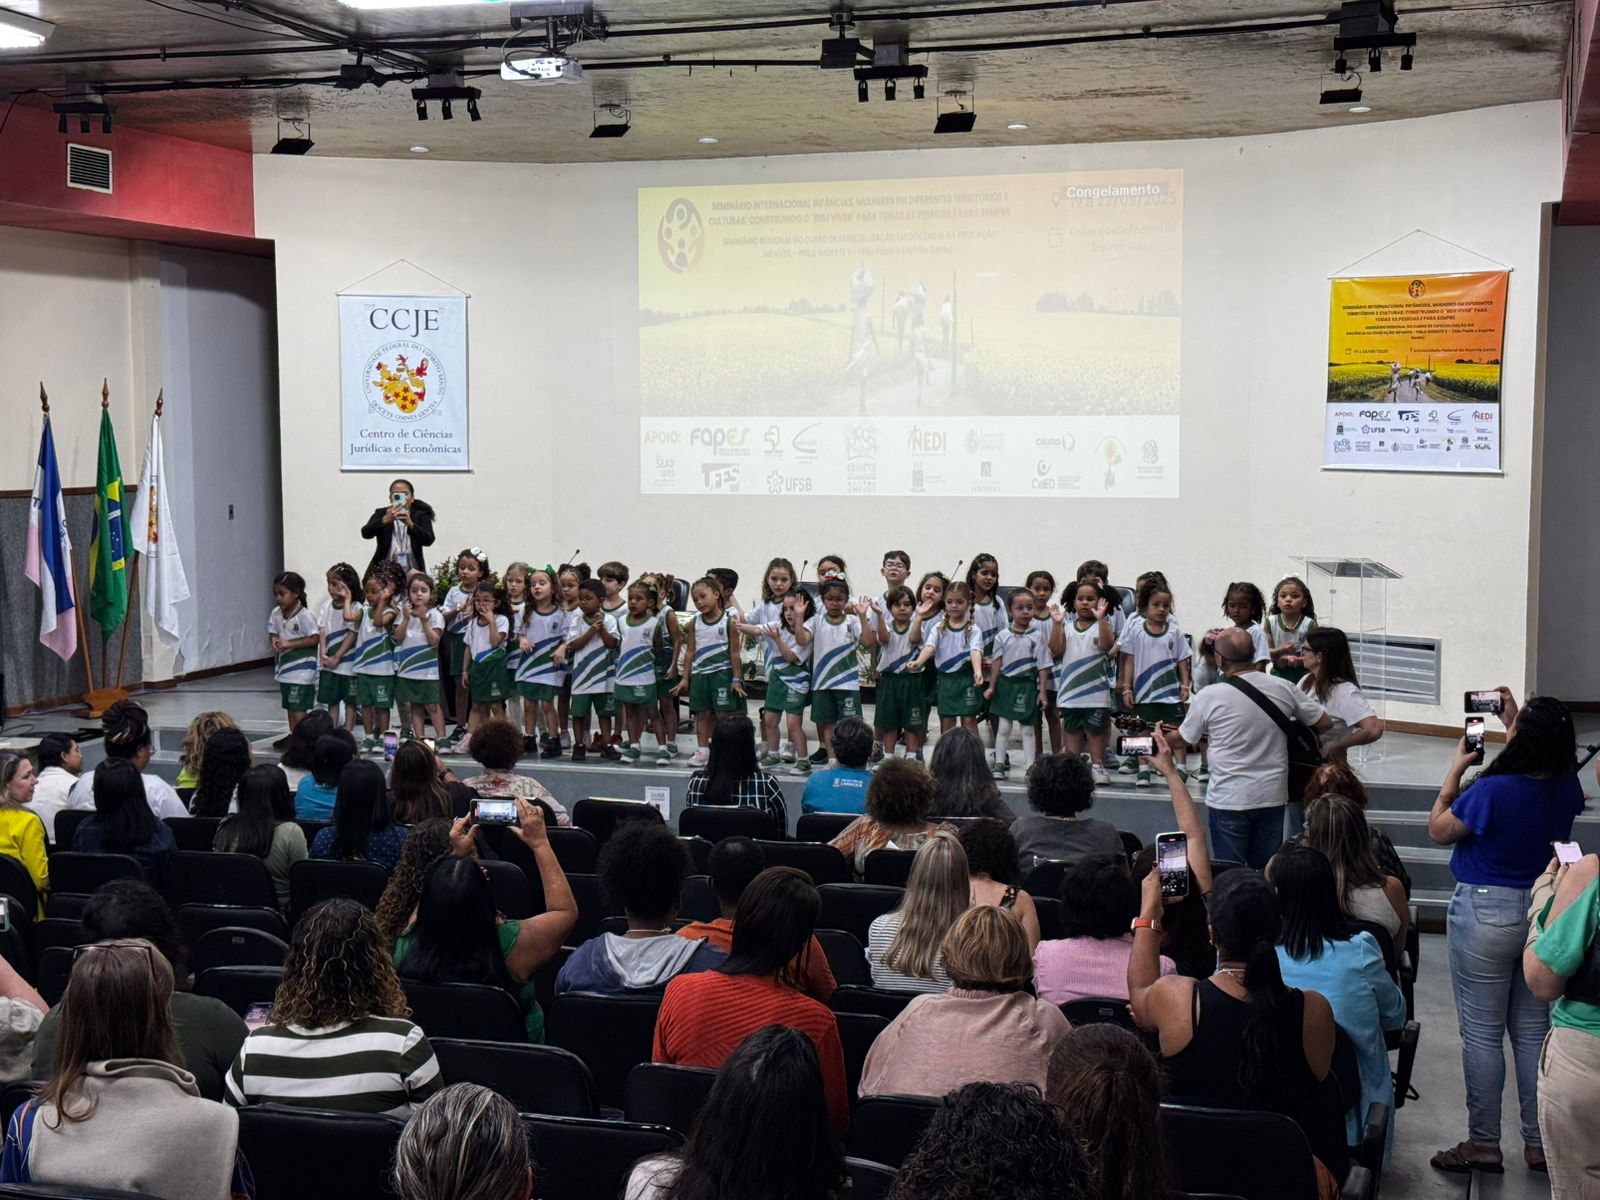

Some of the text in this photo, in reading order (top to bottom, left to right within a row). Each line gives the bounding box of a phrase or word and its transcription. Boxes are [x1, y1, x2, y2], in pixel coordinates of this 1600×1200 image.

[1066, 184, 1160, 199] Congelamento
[753, 198, 811, 209] INTERNACIONAL
[749, 214, 802, 224] CONSTRUINDO
[369, 308, 439, 338] CCJE
[360, 429, 453, 439] Centro de Ciências
[644, 430, 682, 445] APOIO:
[912, 431, 947, 451] NEDI
[349, 443, 392, 455] Jurídicas
[404, 443, 461, 454] Econômicas
[785, 477, 813, 492] UFSB
